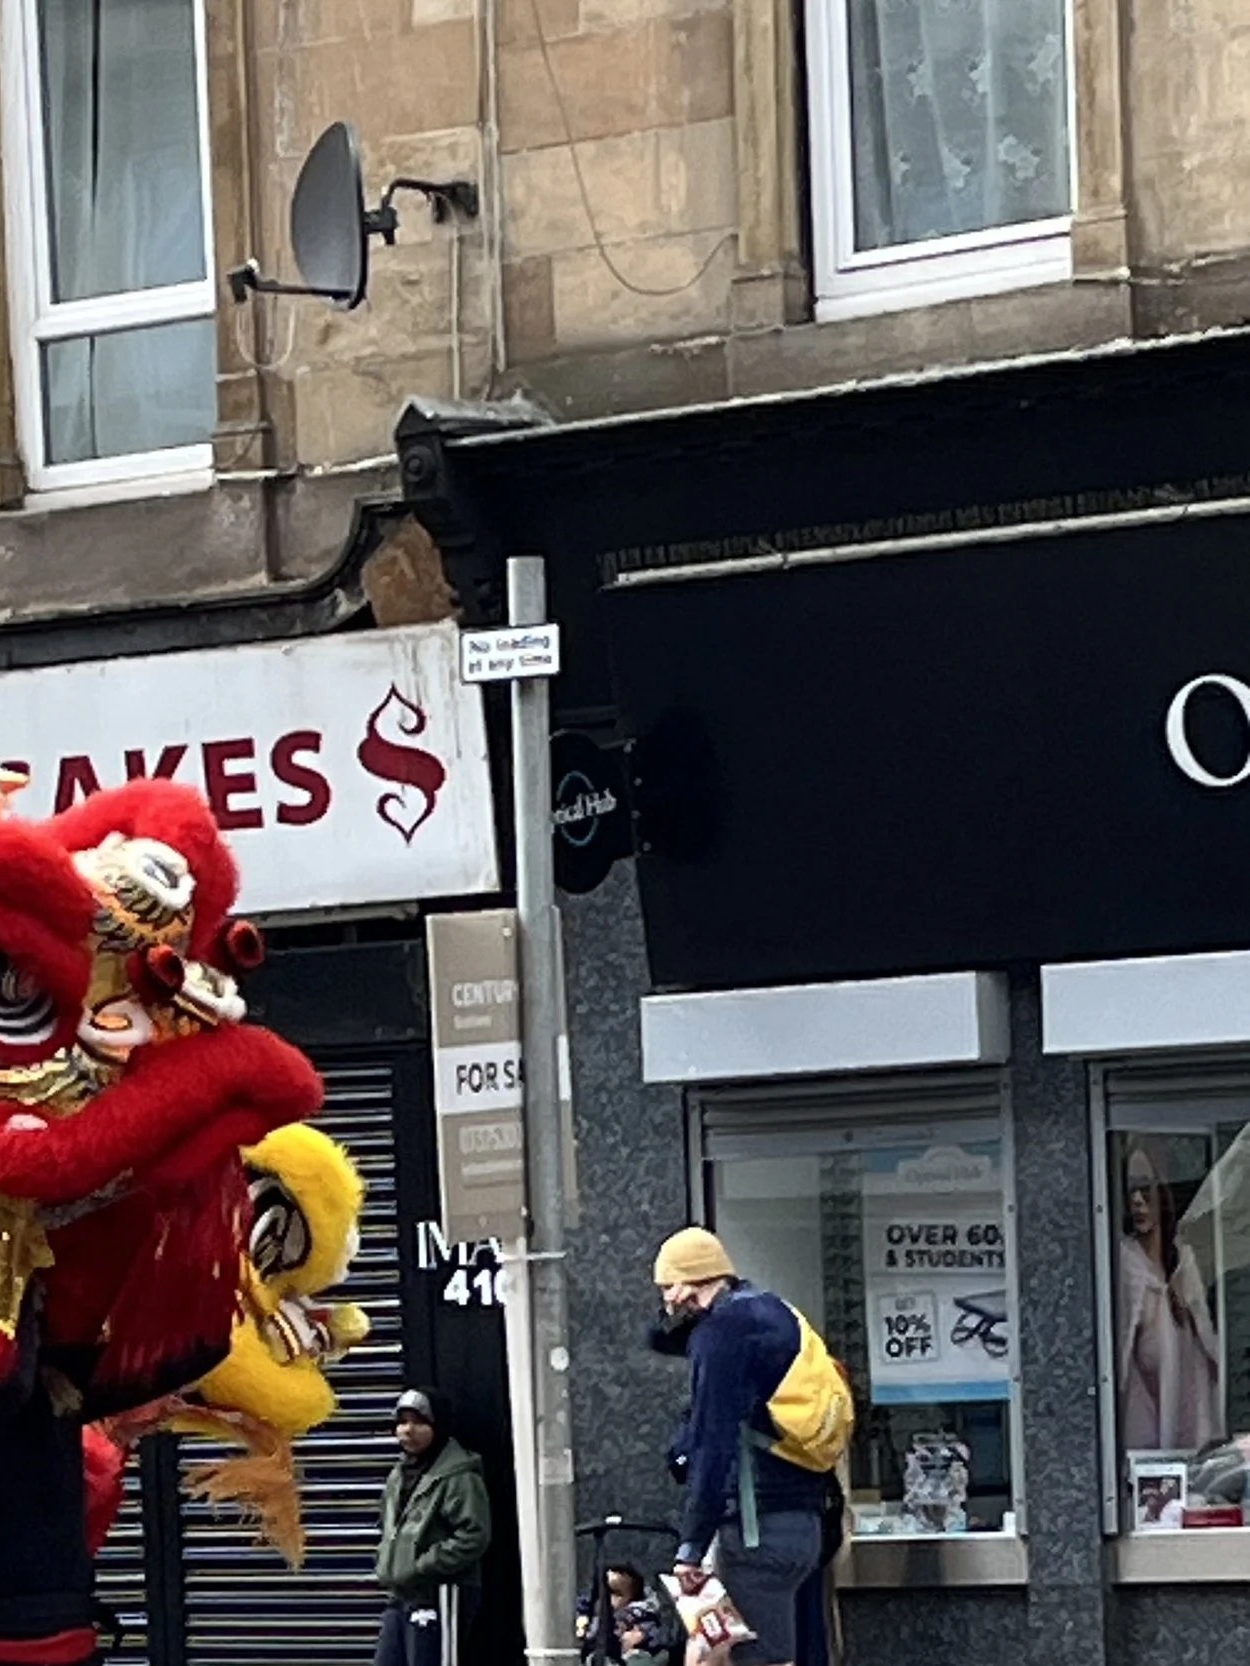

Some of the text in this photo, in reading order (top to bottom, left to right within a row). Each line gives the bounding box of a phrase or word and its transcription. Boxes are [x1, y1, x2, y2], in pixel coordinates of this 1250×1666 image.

[1, 730, 332, 831] AES
[456, 1062, 499, 1095] FOR
[886, 1224, 957, 1246] OVER
[885, 1313, 931, 1336] 10%
[885, 1337, 932, 1359] OFF
